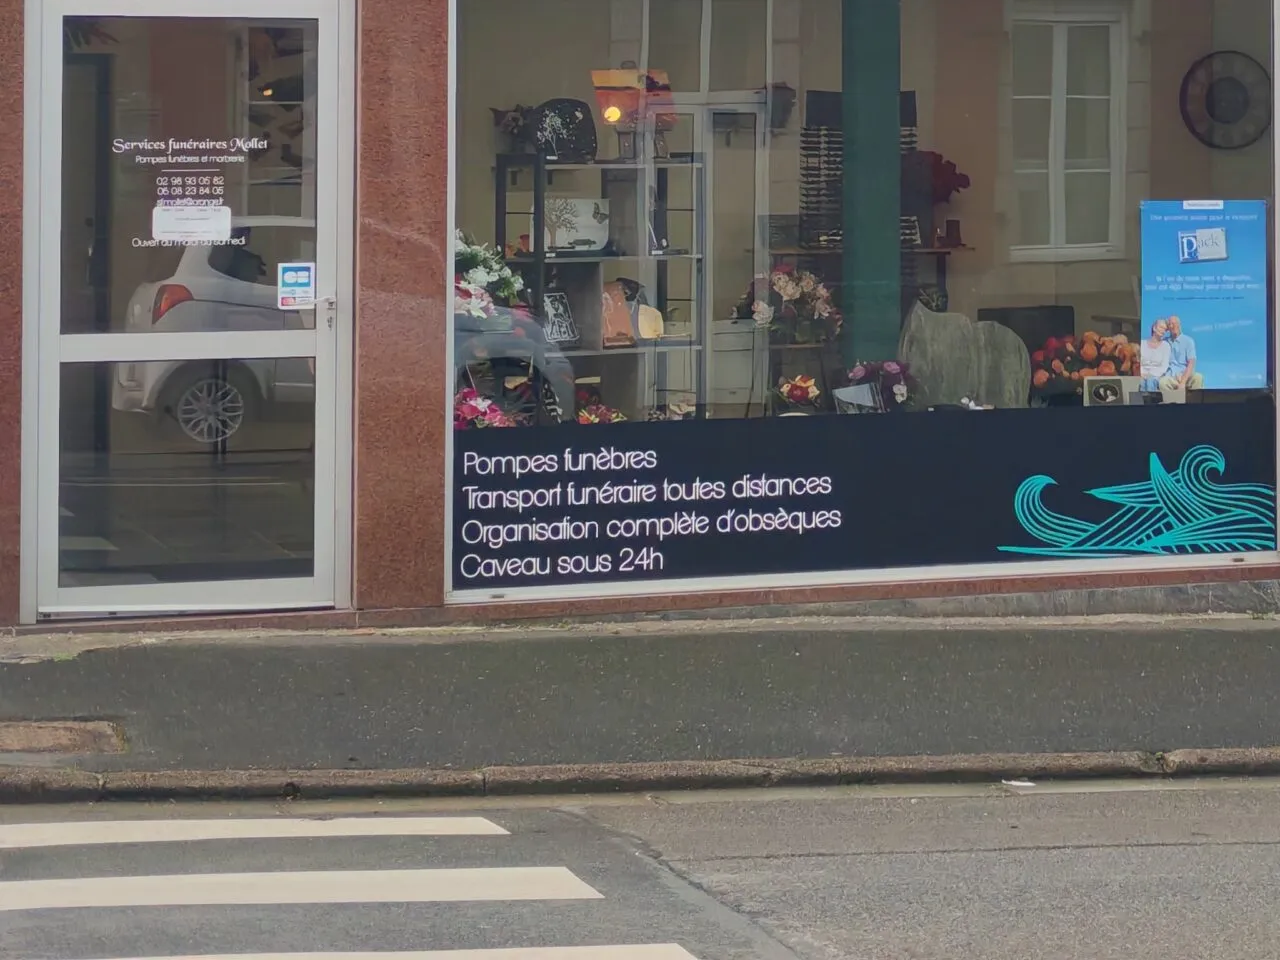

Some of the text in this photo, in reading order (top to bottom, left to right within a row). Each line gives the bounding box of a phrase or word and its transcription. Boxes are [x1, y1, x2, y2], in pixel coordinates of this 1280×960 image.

[112, 137, 268, 154] Services funéraires Mollet
[135, 154, 245, 165] Pompes funèbres et marbrerie
[156, 176, 169, 186] 02
[170, 176, 183, 186] 98
[184, 176, 197, 186] 93
[212, 176, 225, 185] 82
[184, 186, 197, 196] 23
[463, 446, 658, 479] Pompes funèbres
[462, 473, 833, 514] Transport funéraire toutes distances
[461, 507, 842, 549] Organisation complète d'obsèques
[460, 546, 664, 579] Caveau sous 24h
